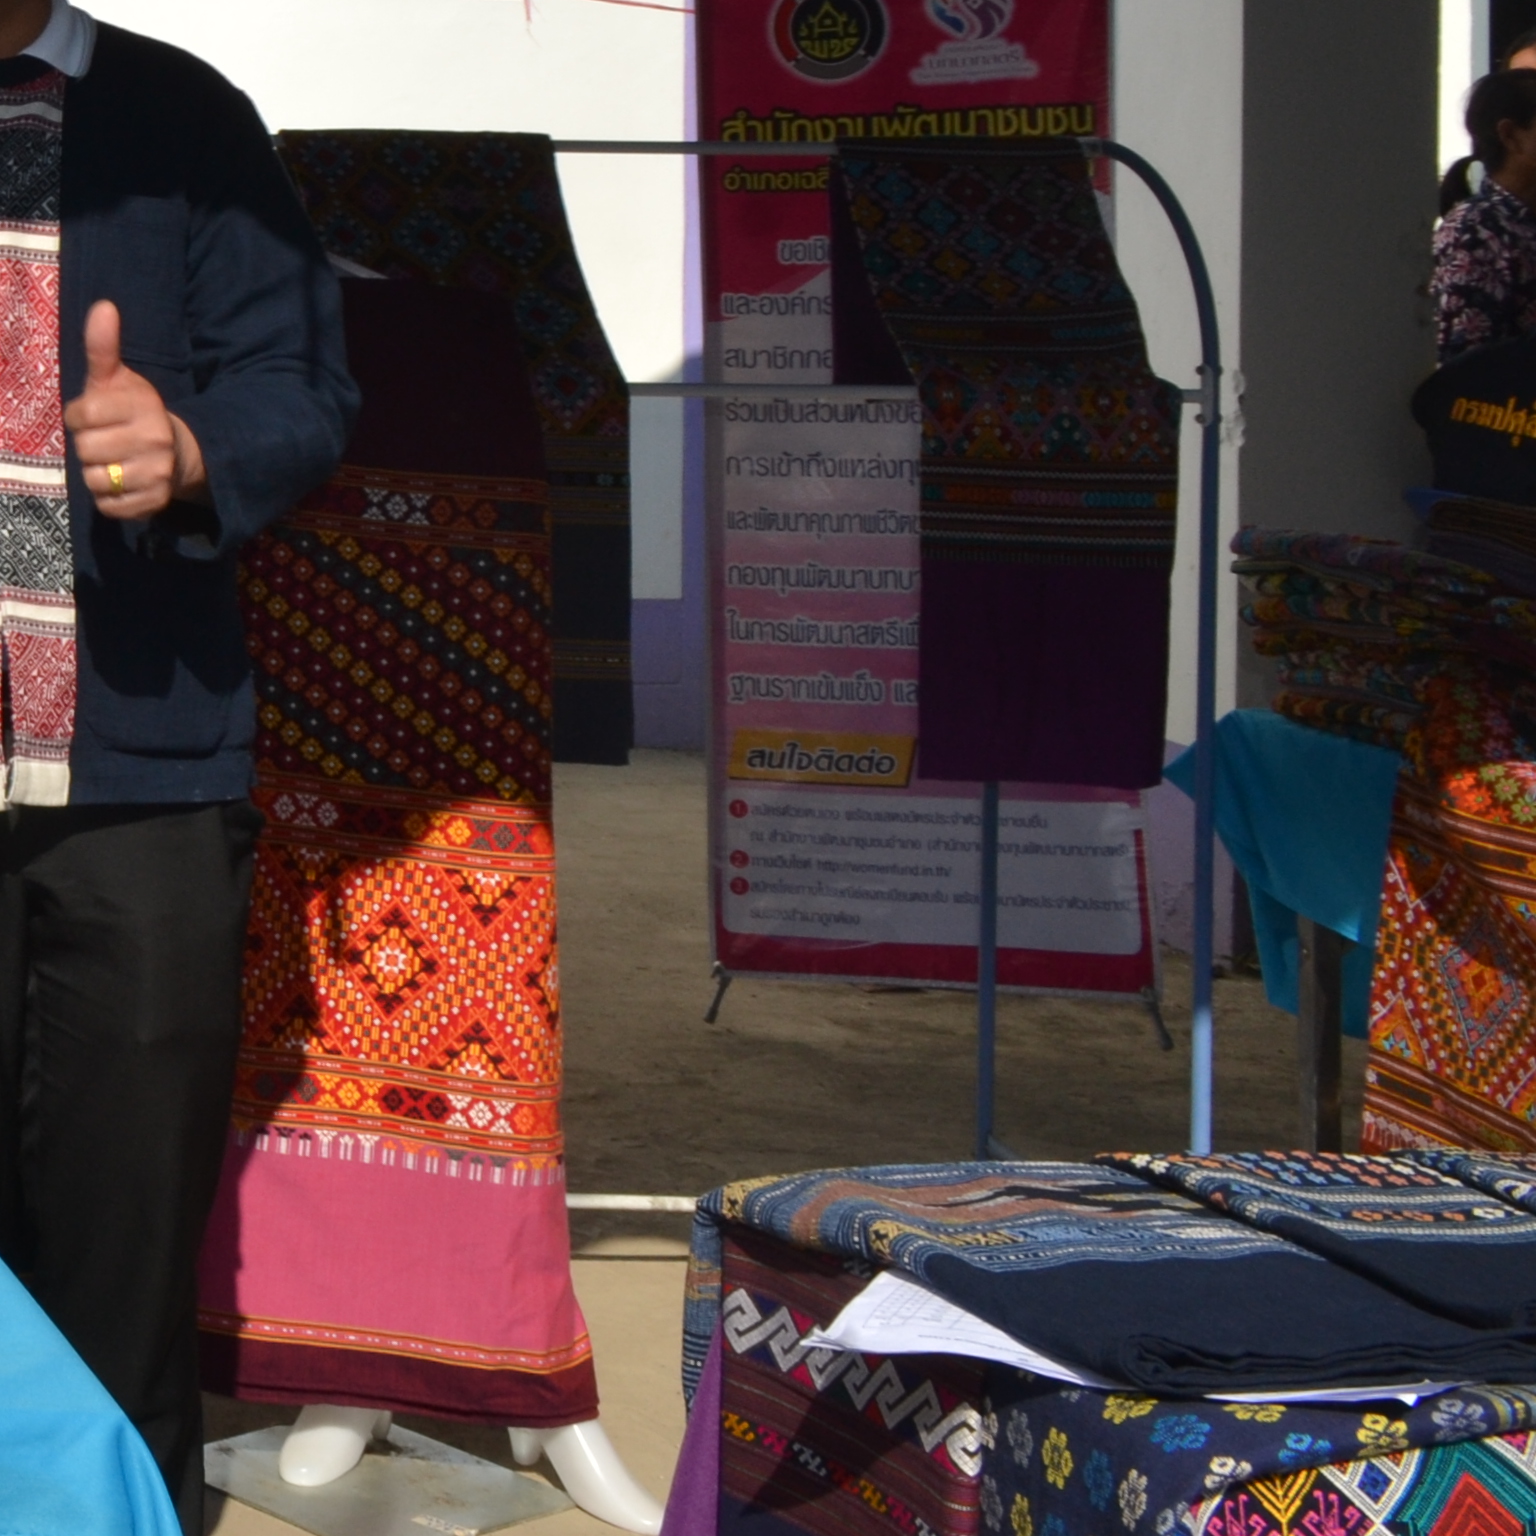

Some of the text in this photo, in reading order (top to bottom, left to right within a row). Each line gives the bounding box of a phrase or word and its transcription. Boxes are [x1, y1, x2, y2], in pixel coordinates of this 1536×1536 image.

[722, 103, 1093, 143] สำนักงานพัฒนาชมชน
[780, 238, 831, 262] ขอเชิ
[725, 452, 920, 486] การเข้าถึงแหล่งทุ
[729, 672, 882, 702] ฐานรากเข้มแข็ง
[746, 743, 896, 774] สนใจติดต่อ
